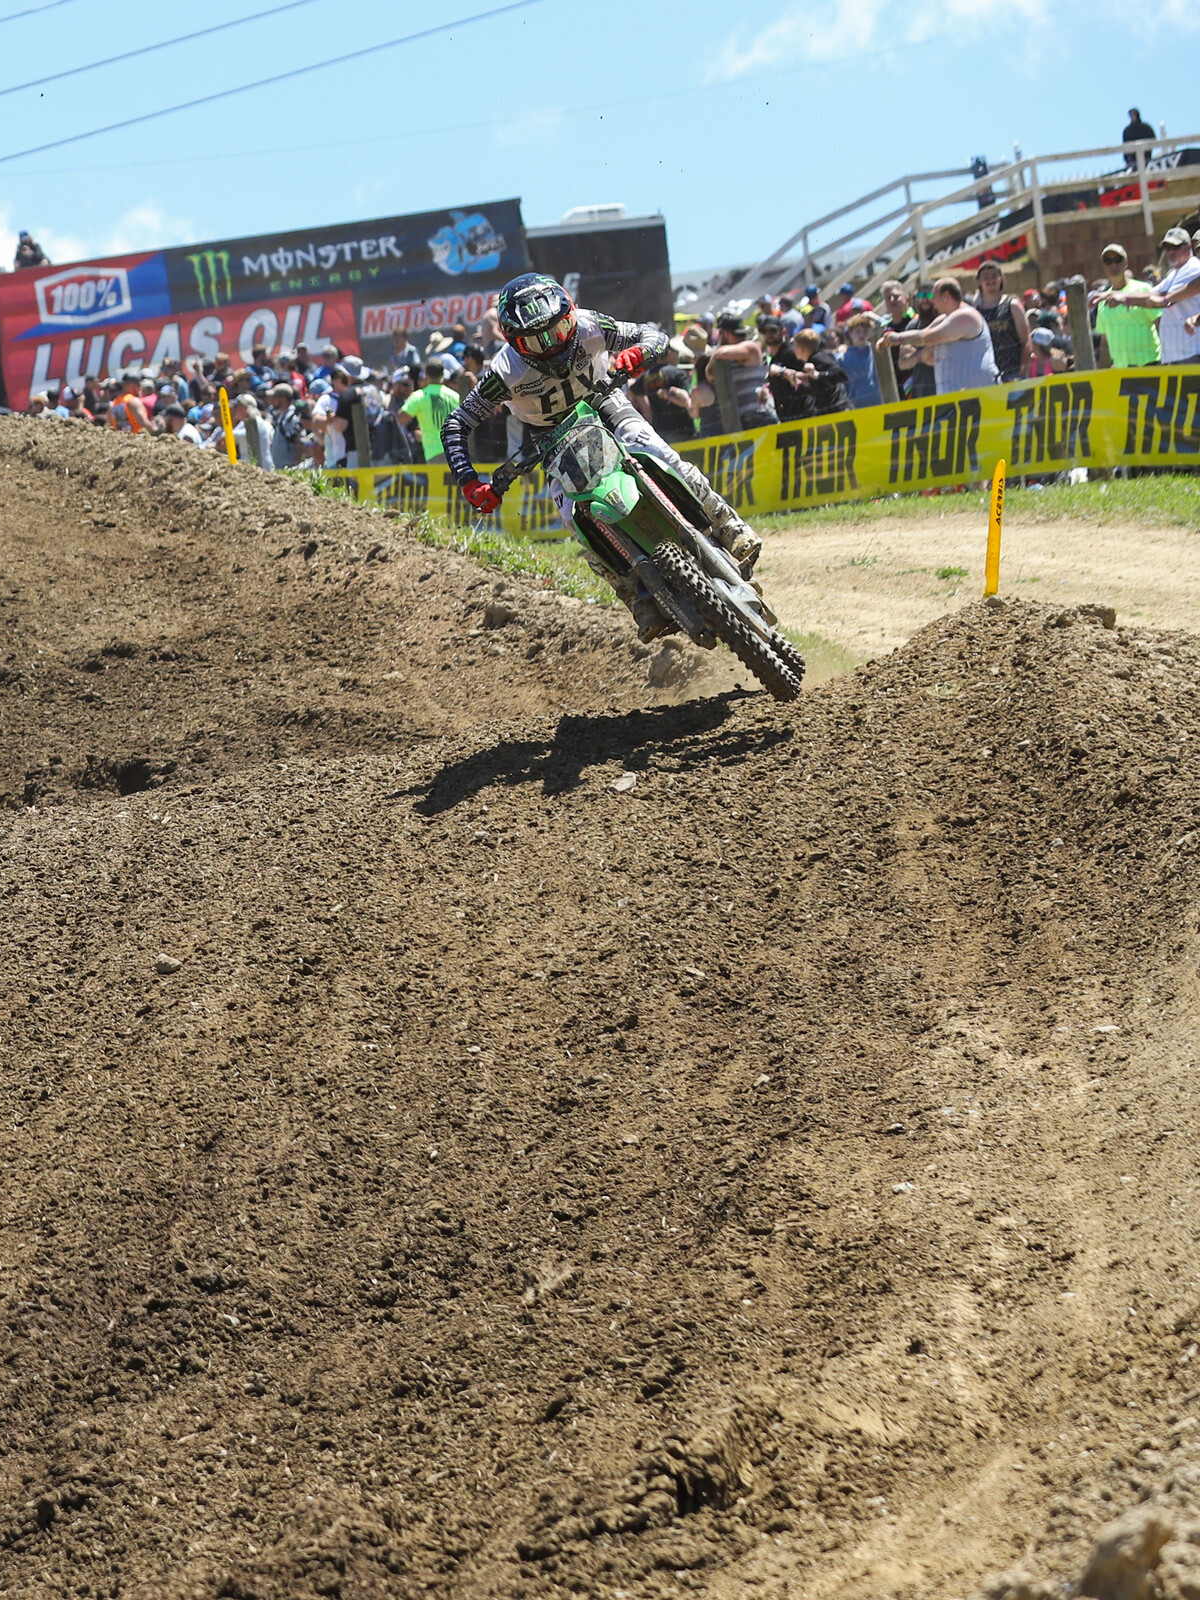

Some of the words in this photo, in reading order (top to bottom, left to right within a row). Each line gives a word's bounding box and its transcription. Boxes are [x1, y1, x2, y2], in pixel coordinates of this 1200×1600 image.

[241, 235, 403, 278] MONSTER
[270, 266, 380, 293] ENERGY
[49, 276, 118, 315] 100%
[29, 315, 224, 400] LUCAS
[238, 302, 333, 372] OIL
[539, 361, 594, 414] FLY
[634, 429, 651, 447] FLY
[776, 420, 859, 501] THOR
[883, 397, 982, 484] THOR
[1006, 381, 1095, 467] THOR
[995, 477, 1005, 526] ACERBIS
